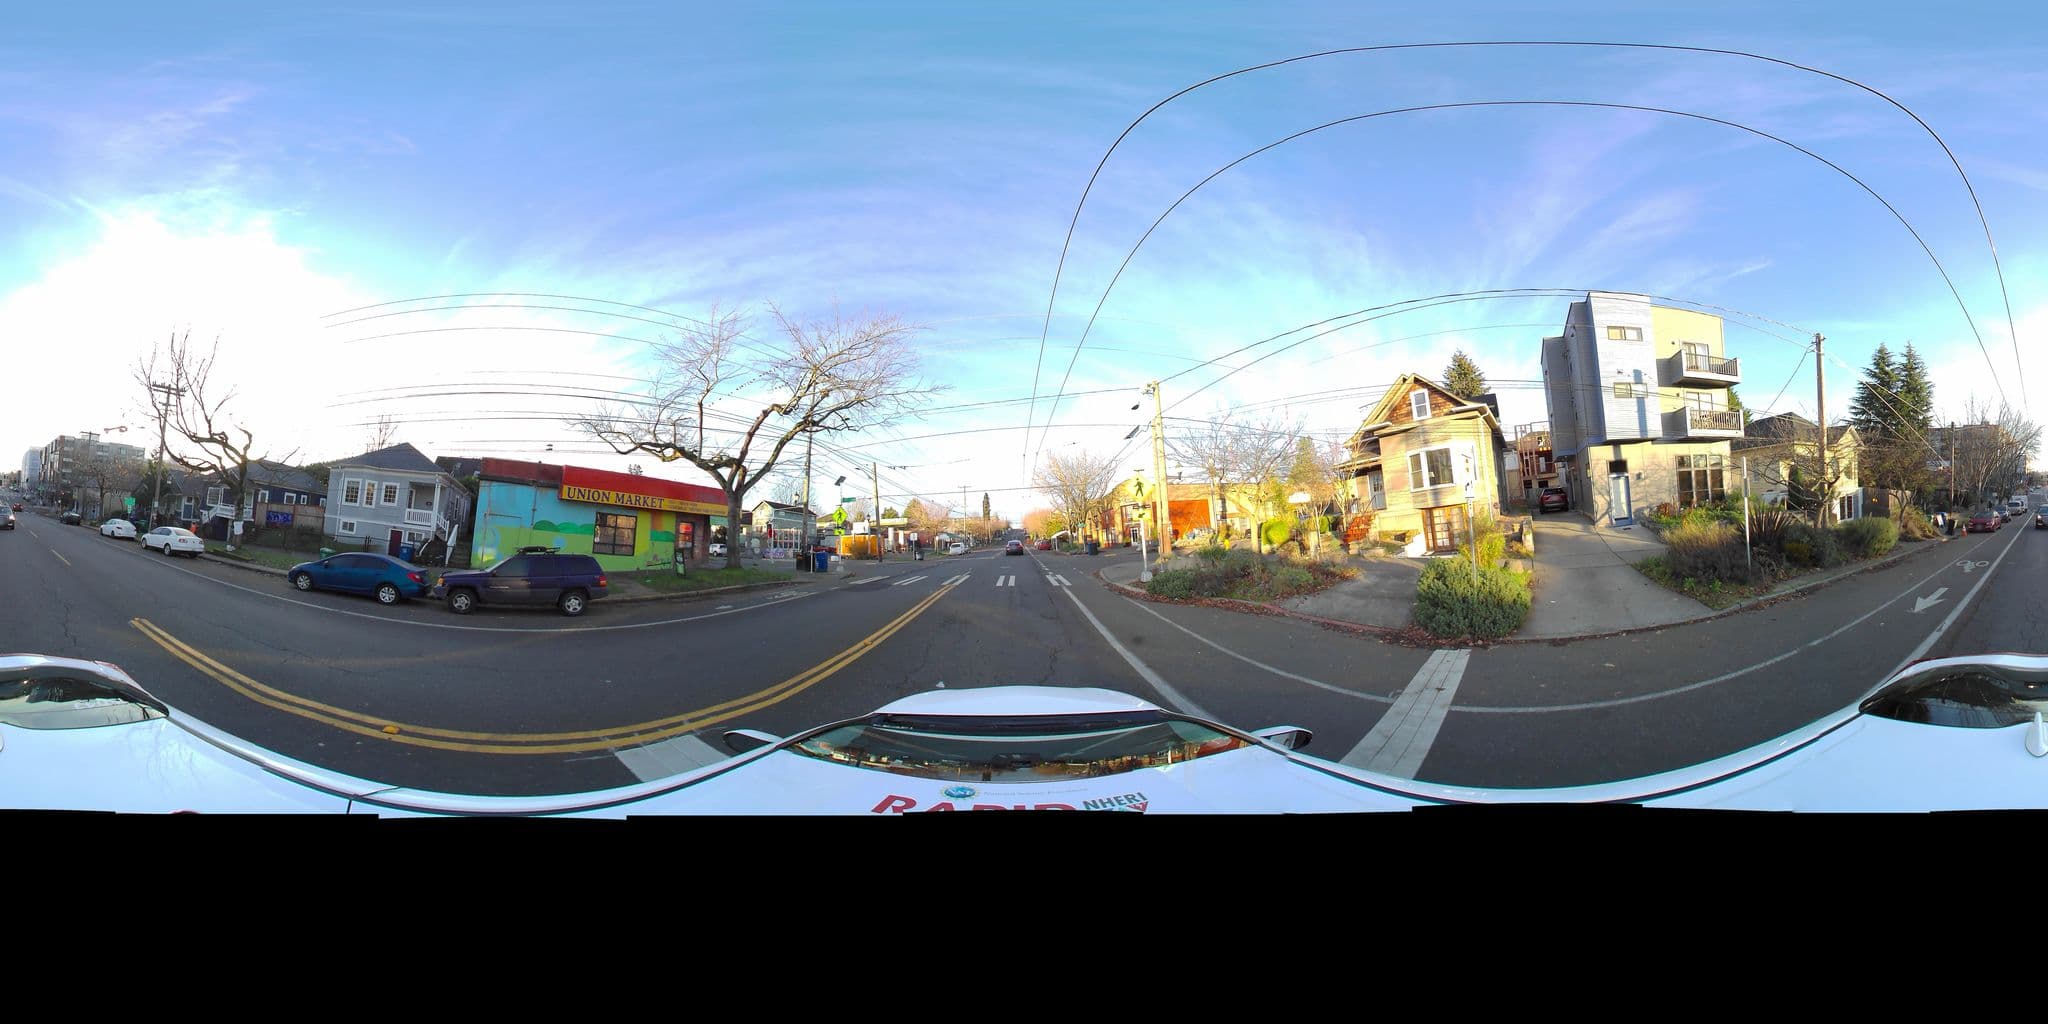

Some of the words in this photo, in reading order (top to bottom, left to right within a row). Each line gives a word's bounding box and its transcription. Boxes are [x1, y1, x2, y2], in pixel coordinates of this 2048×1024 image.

[567, 487, 610, 503] UNION
[615, 492, 664, 508] MARKET
[1083, 792, 1148, 810] NHERI
